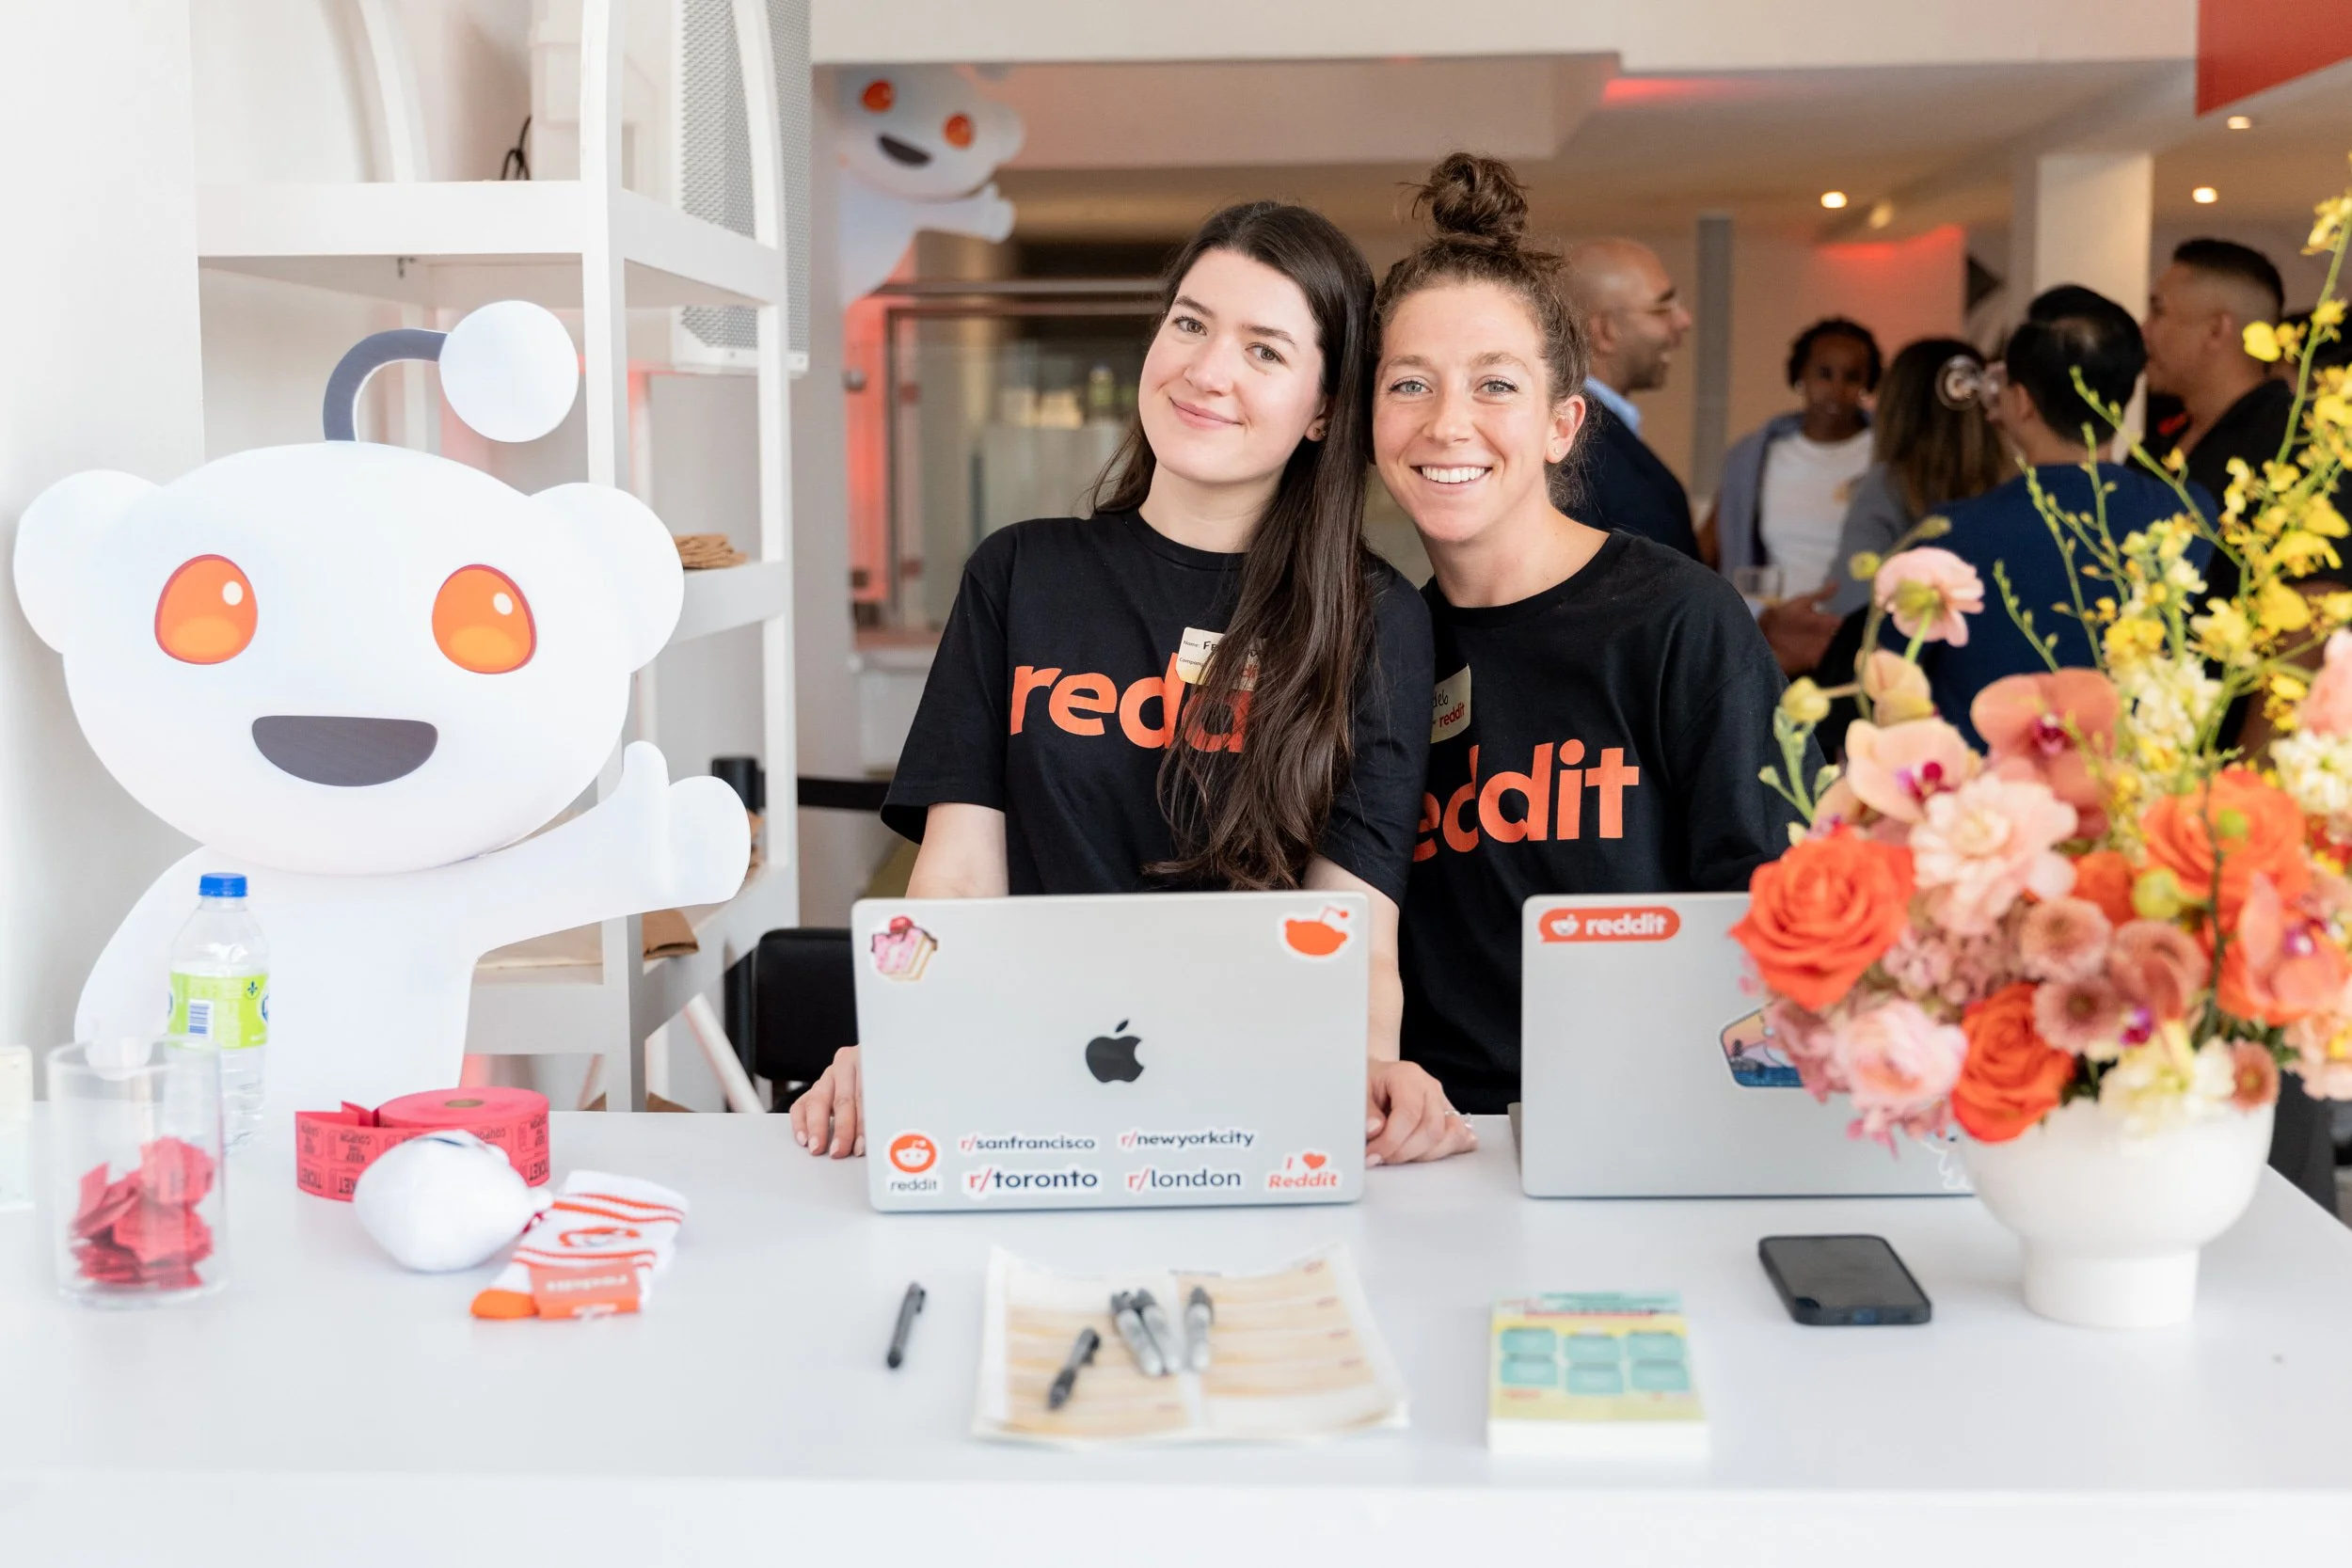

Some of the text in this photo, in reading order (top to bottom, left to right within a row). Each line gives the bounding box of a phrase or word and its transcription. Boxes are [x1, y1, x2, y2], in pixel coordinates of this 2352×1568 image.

[1179, 657, 1204, 667] Company
[1010, 652, 1256, 752] redd
[1438, 701, 1465, 728] reddit
[1412, 738, 1640, 862] eddit
[1584, 912, 1667, 936] reddit
[960, 1135, 1096, 1151] r/sanfrancisco
[1120, 1130, 1254, 1148] r/newyorkcity
[1285, 1157, 1294, 1170] I
[890, 1178, 937, 1192] reddit
[968, 1167, 1099, 1193] r/toronto
[1128, 1167, 1242, 1192] r/london
[1267, 1171, 1338, 1189] Reddit
